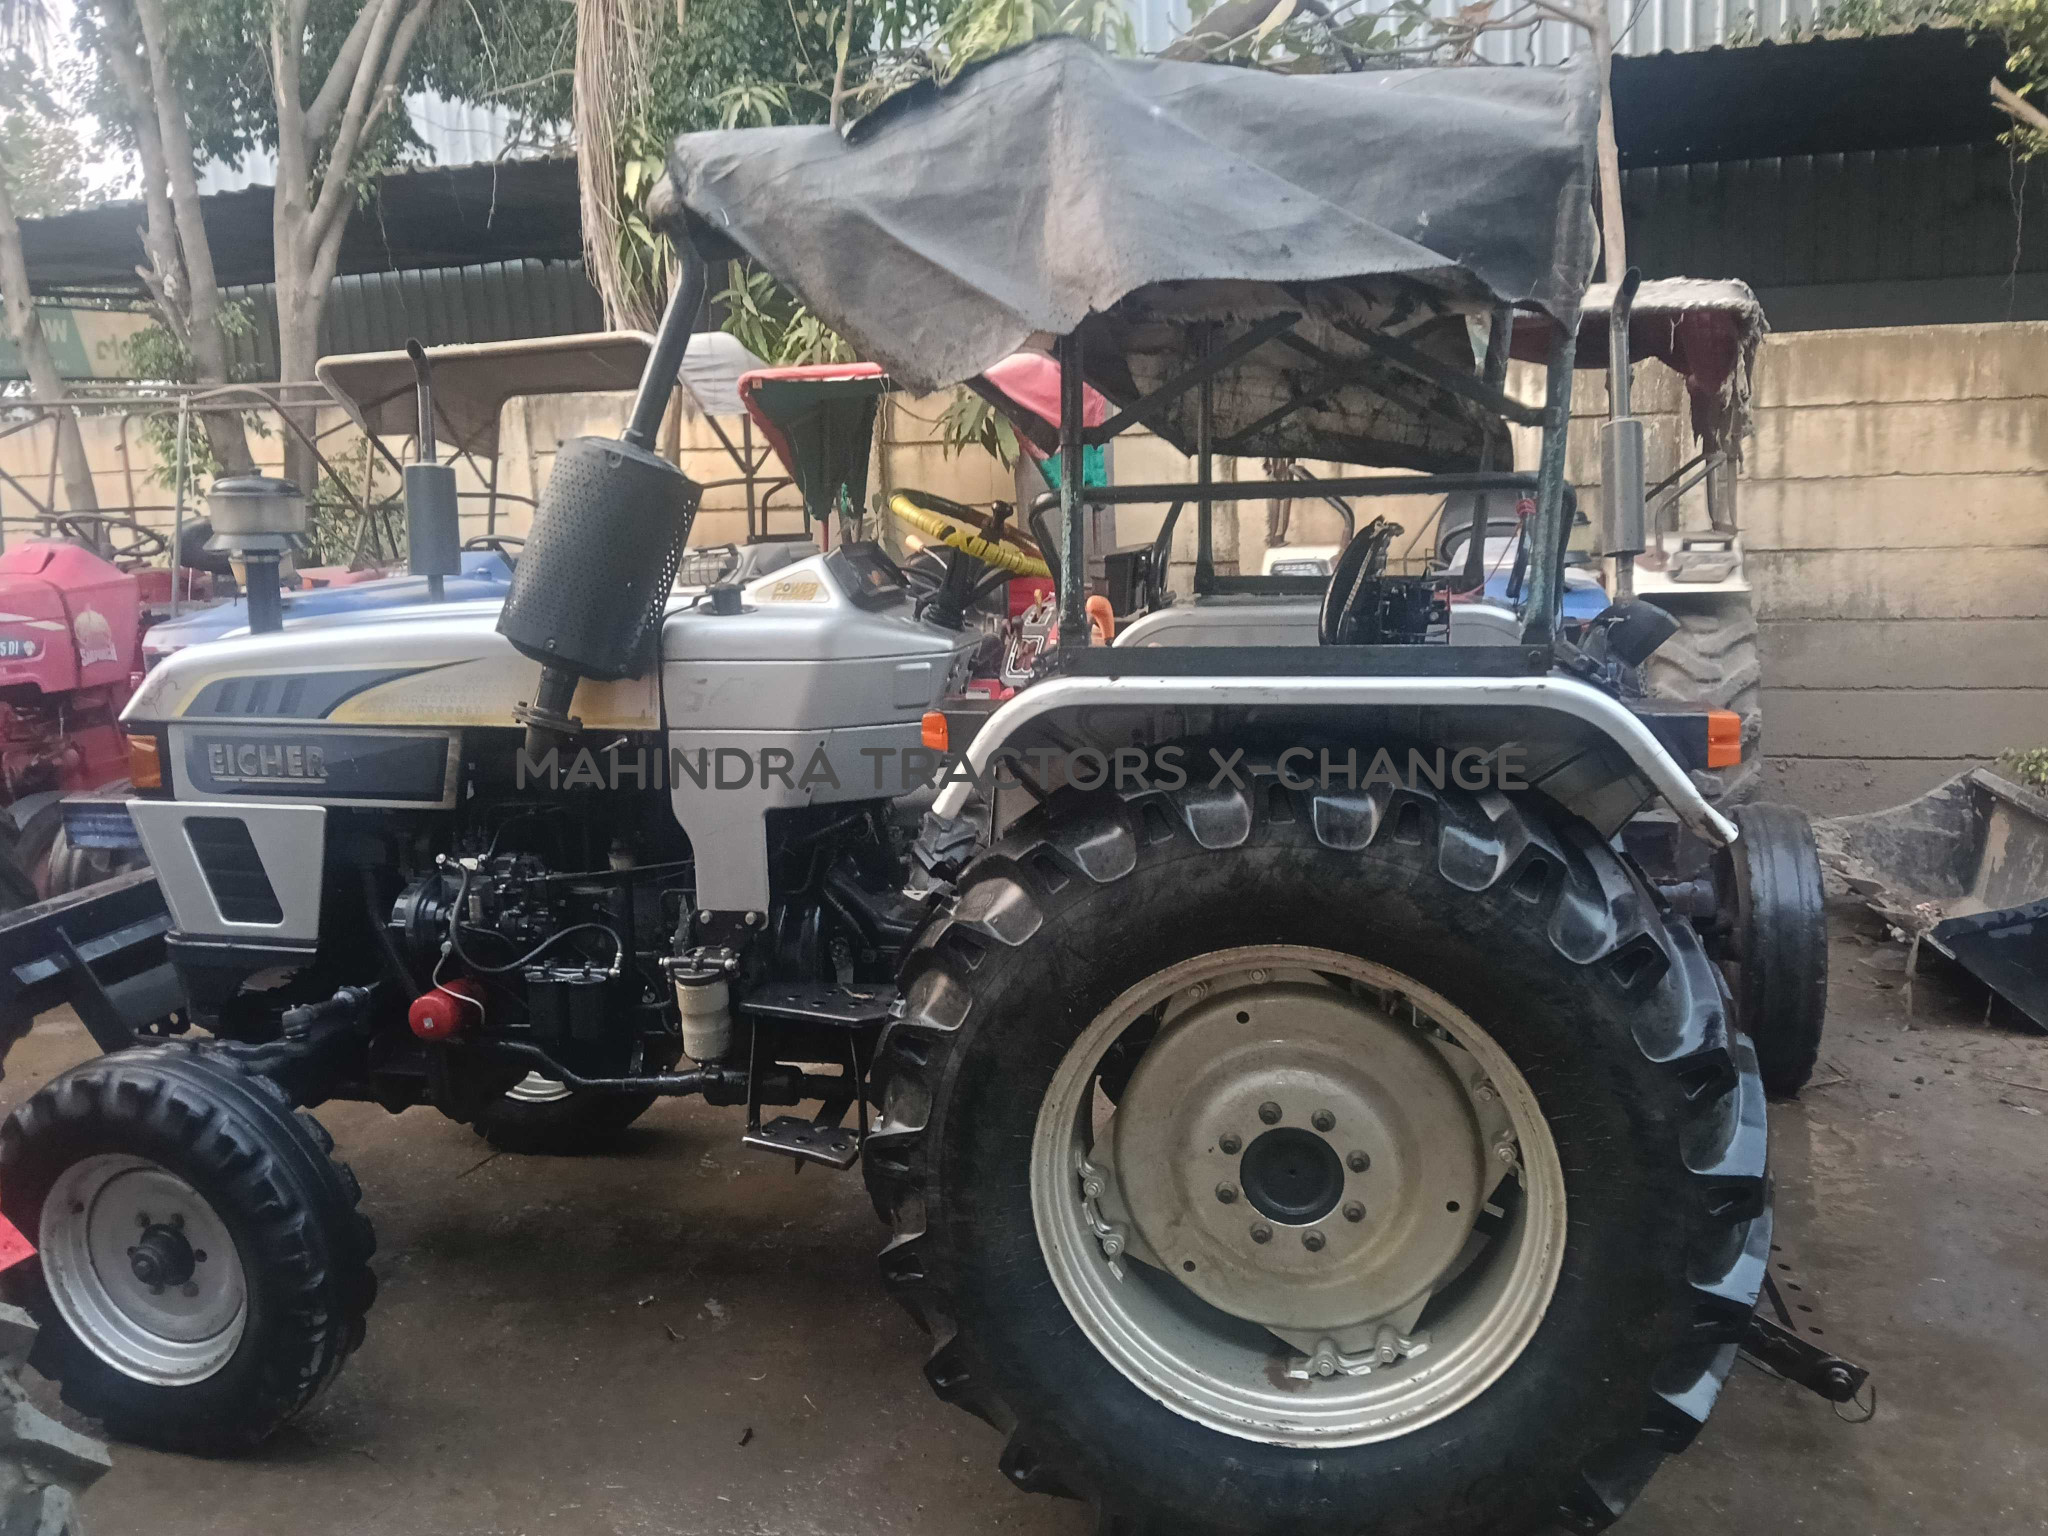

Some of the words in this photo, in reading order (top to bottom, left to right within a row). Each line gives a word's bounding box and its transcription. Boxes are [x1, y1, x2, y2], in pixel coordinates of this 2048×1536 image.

[773, 582, 819, 594] POWER
[8, 640, 19, 655] DI
[207, 743, 329, 777] EICHER
